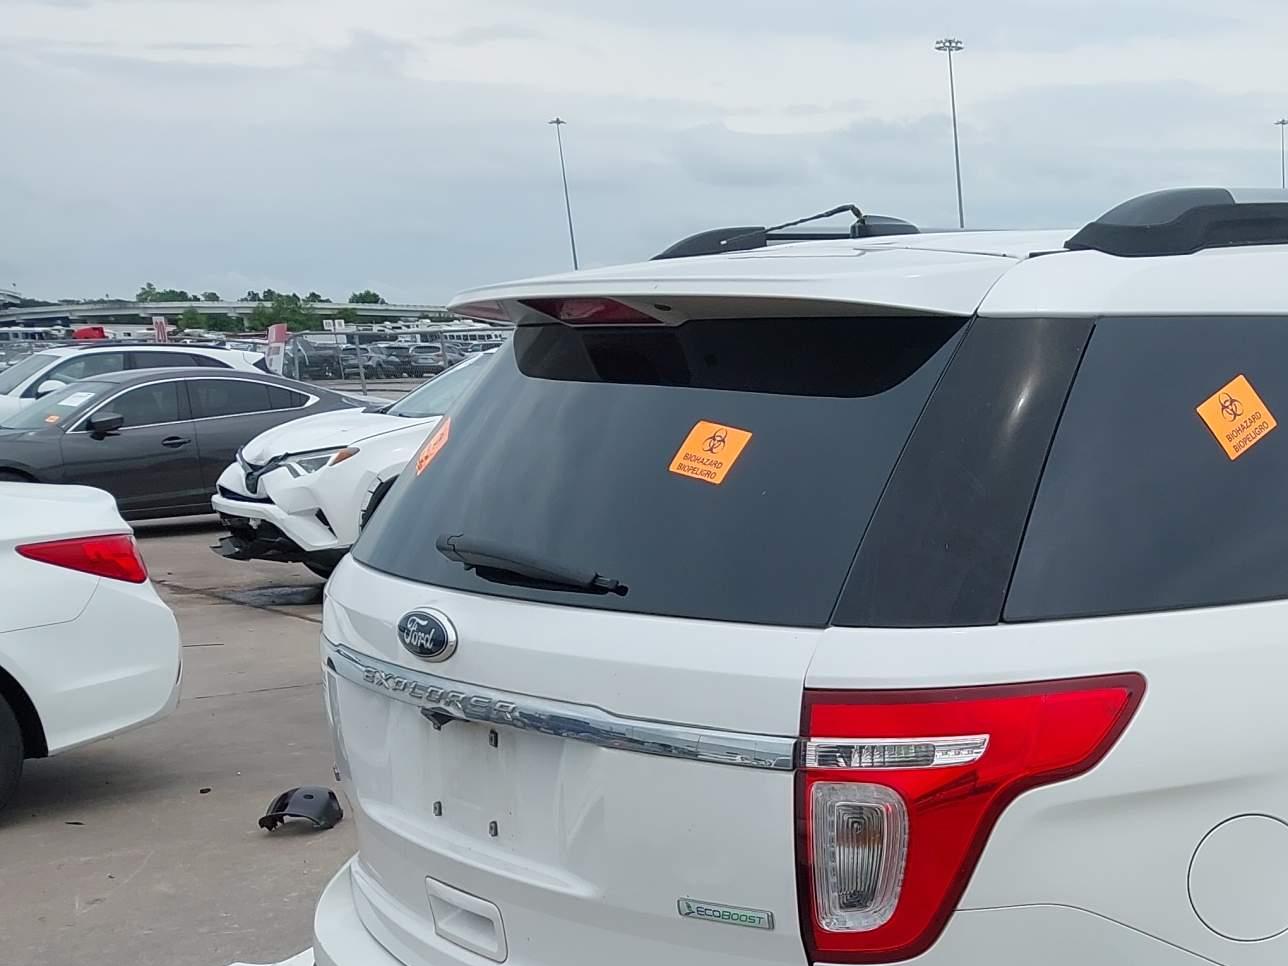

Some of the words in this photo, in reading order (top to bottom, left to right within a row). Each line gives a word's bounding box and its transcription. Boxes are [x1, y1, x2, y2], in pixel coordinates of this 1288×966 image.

[1225, 411, 1262, 442] BIOHAZARD
[1232, 420, 1269, 453] BIOPELIGRO
[676, 462, 717, 480] BIOPELIGRO
[683, 452, 723, 470] BIOHAZARD
[403, 616, 436, 649] Ford
[363, 668, 518, 721] EXPLORER
[696, 906, 765, 925] ECOBOOST
